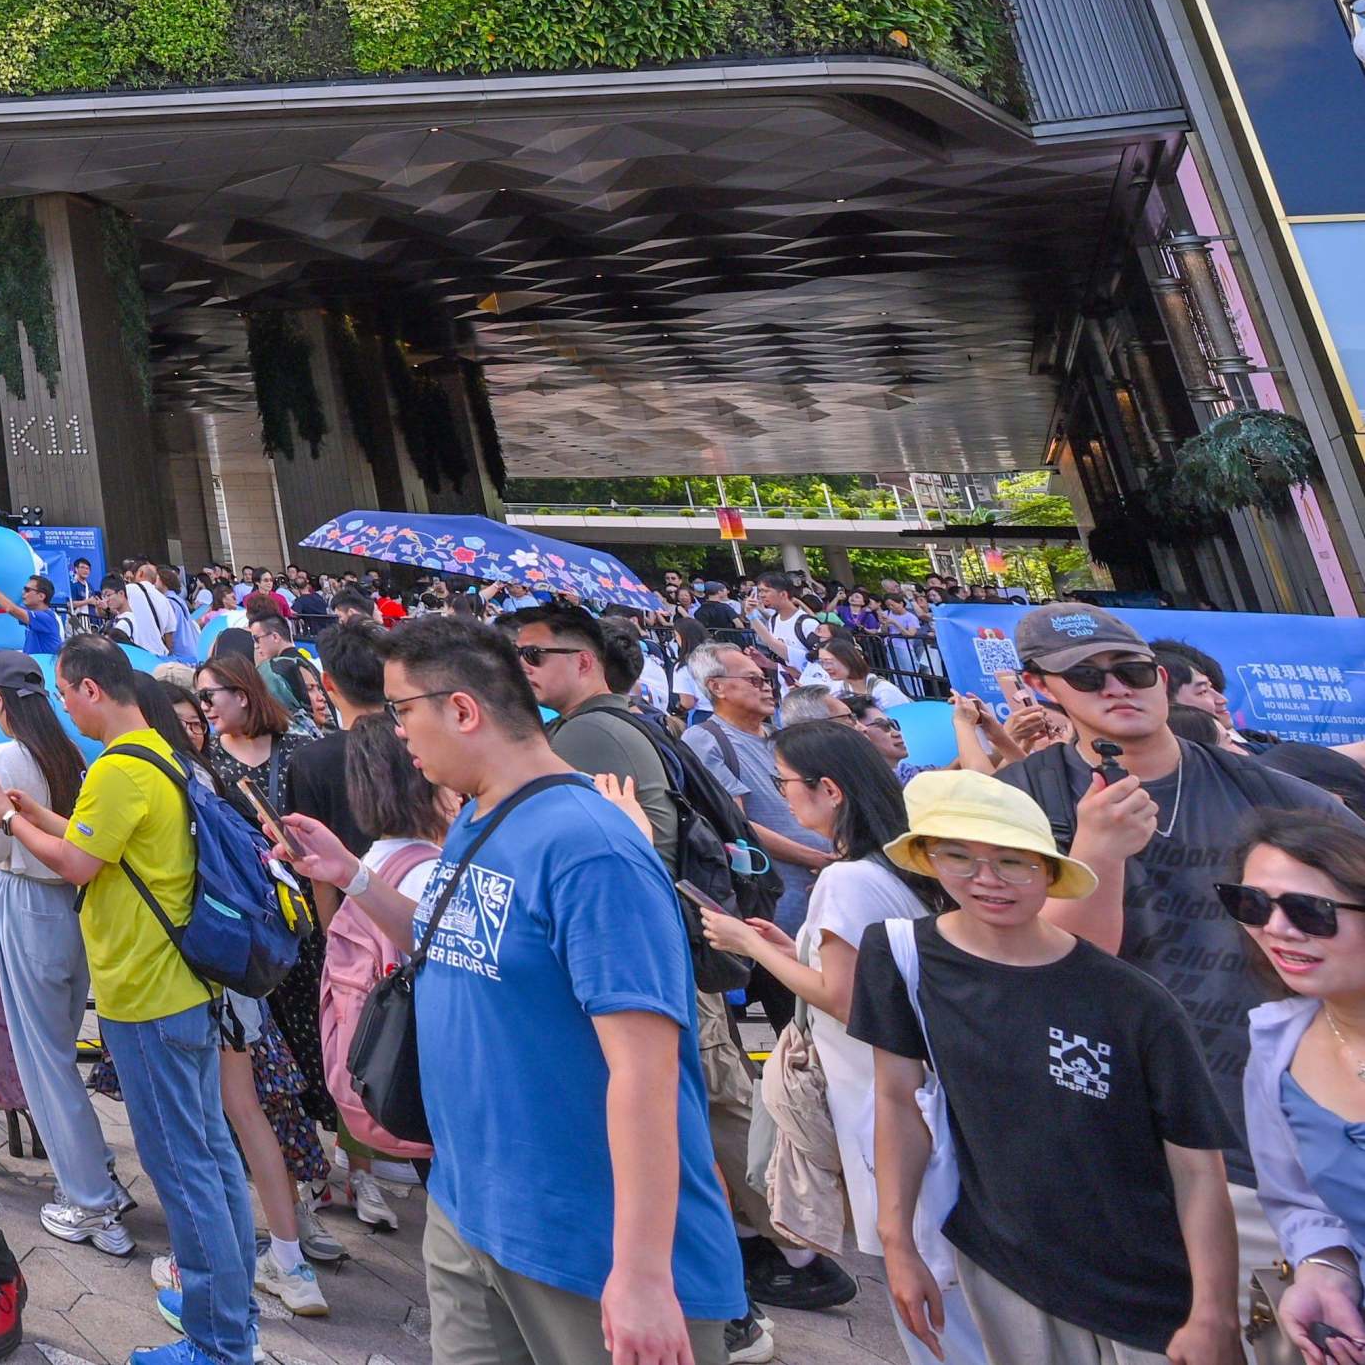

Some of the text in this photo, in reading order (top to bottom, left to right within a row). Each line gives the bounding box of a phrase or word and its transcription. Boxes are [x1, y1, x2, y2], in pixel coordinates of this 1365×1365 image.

[9, 415, 88, 456] K11
[1067, 628, 1094, 637] Club
[1264, 701, 1276, 709] NO
[1267, 713, 1284, 721] FOR
[1285, 714, 1313, 723] ONLINE
[1055, 1077, 1107, 1100] INSPIRED
